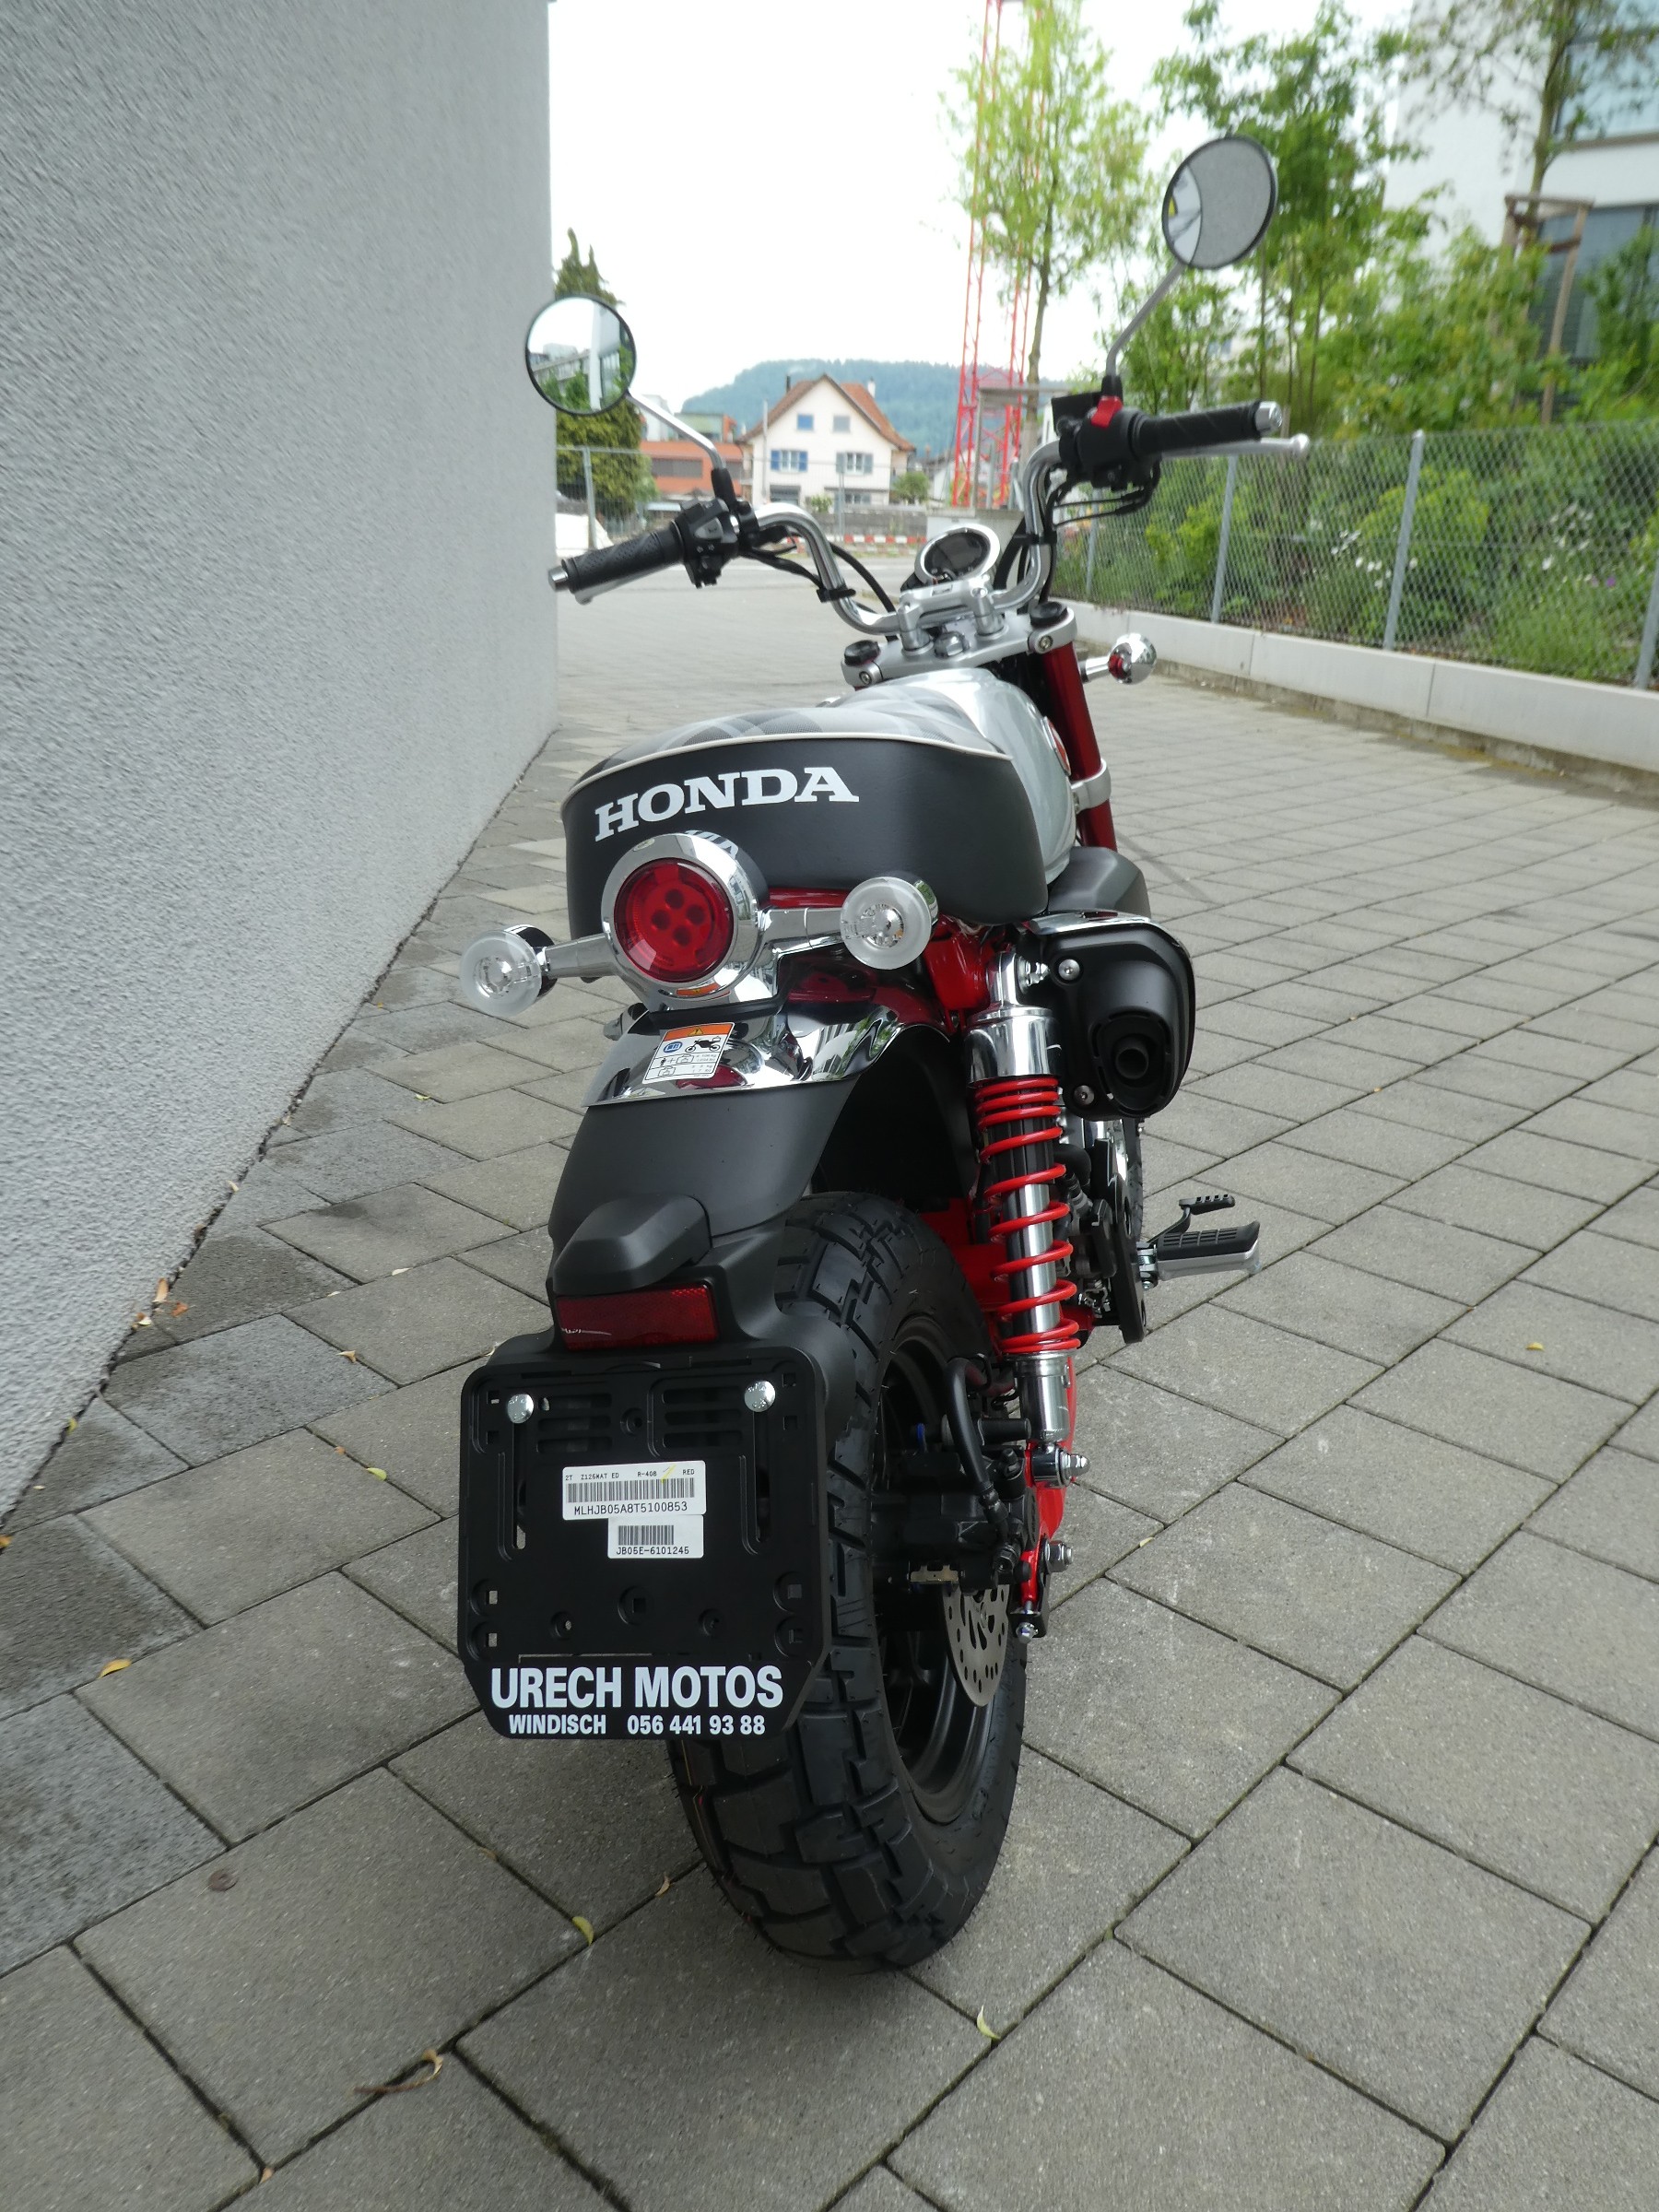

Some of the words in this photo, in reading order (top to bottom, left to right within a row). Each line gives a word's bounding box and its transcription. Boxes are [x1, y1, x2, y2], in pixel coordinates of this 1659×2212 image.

[594, 765, 860, 842] HONDA
[574, 1500, 688, 1516] MLHJB05A8T5100853
[616, 1546, 689, 1556] JB05E-6101245
[490, 1666, 623, 1709] URECH
[634, 1665, 784, 1709] MOTOS
[509, 1713, 606, 1735] WINDISCH
[627, 1714, 664, 1735] 056
[669, 1714, 701, 1735] 441
[709, 1714, 735, 1735] 93
[740, 1714, 766, 1735] 88
